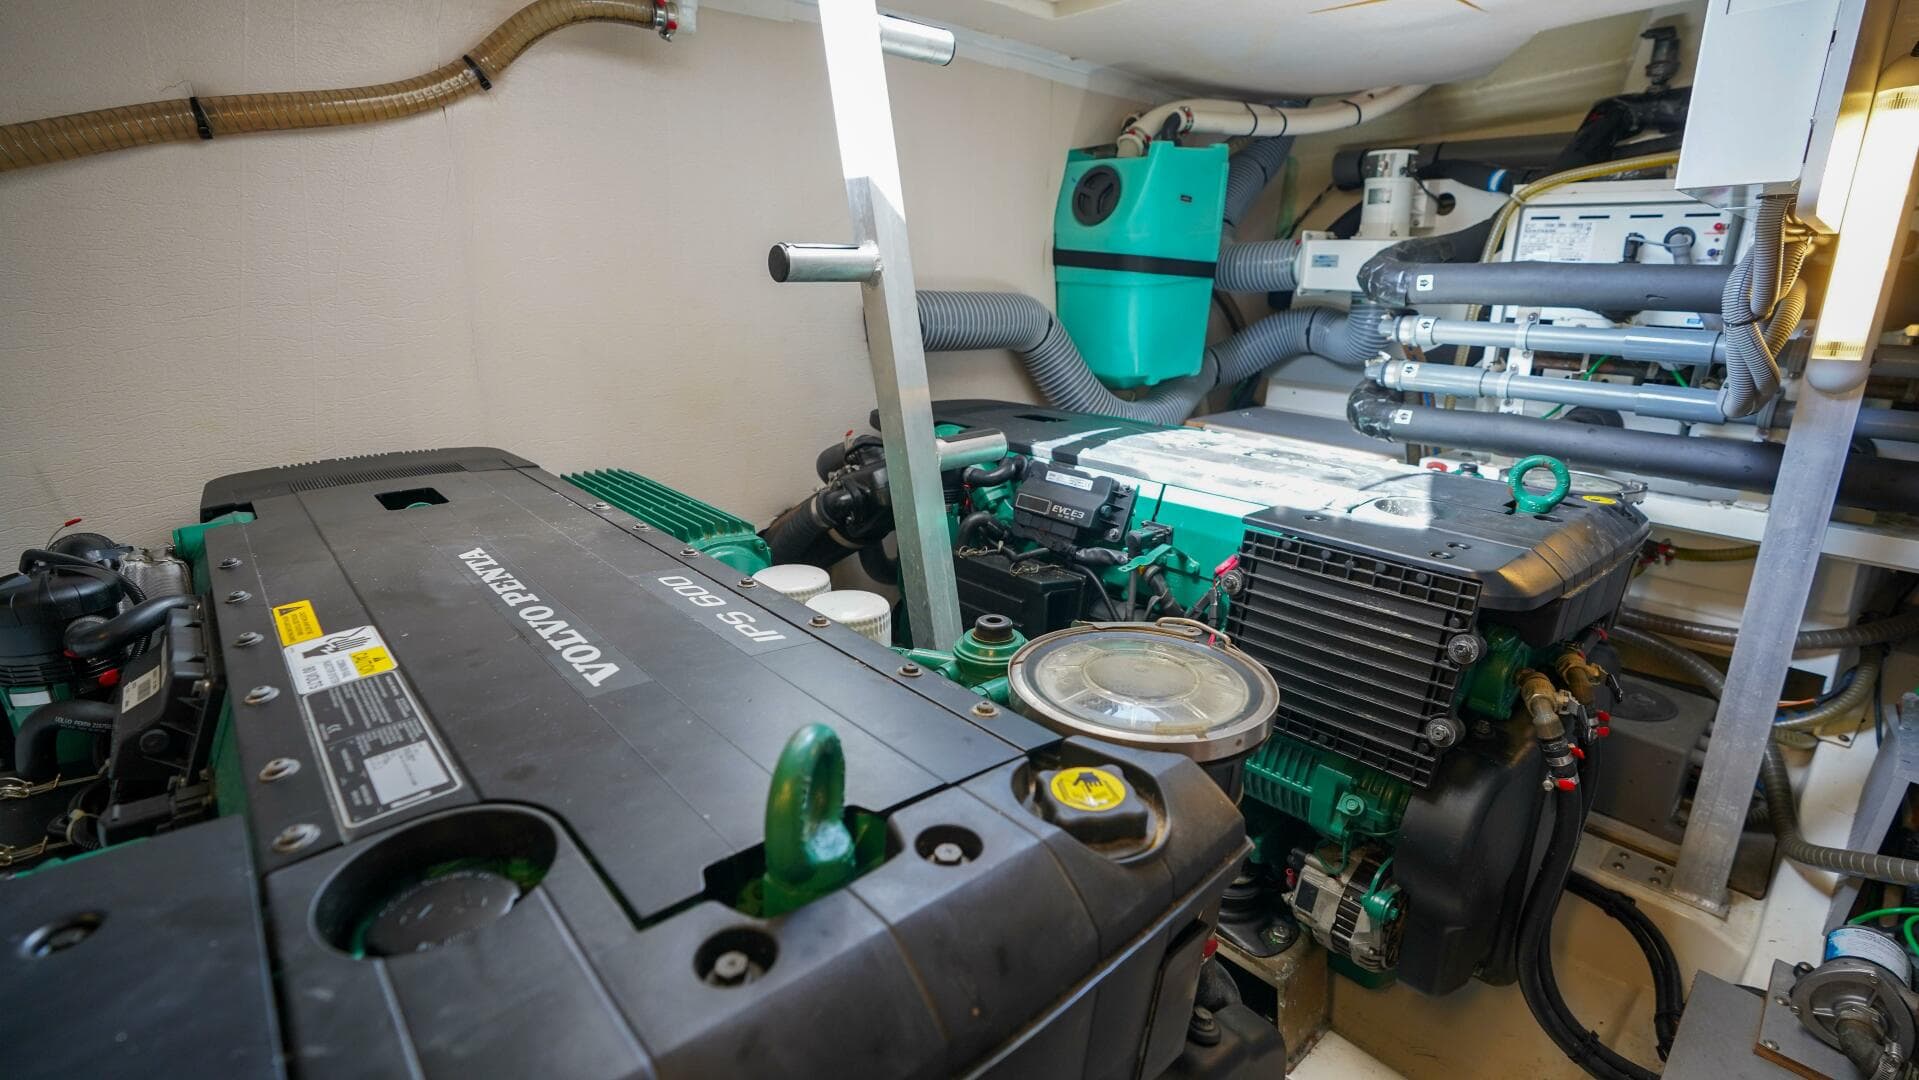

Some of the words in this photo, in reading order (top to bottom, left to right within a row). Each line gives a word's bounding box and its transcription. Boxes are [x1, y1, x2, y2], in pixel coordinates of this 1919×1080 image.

[1052, 504, 1071, 515] EVC
[1071, 509, 1085, 519] E3
[458, 547, 540, 607] PENTA
[658, 575, 728, 607] 600
[716, 611, 787, 642] IPS
[519, 605, 620, 687] VOLVO
